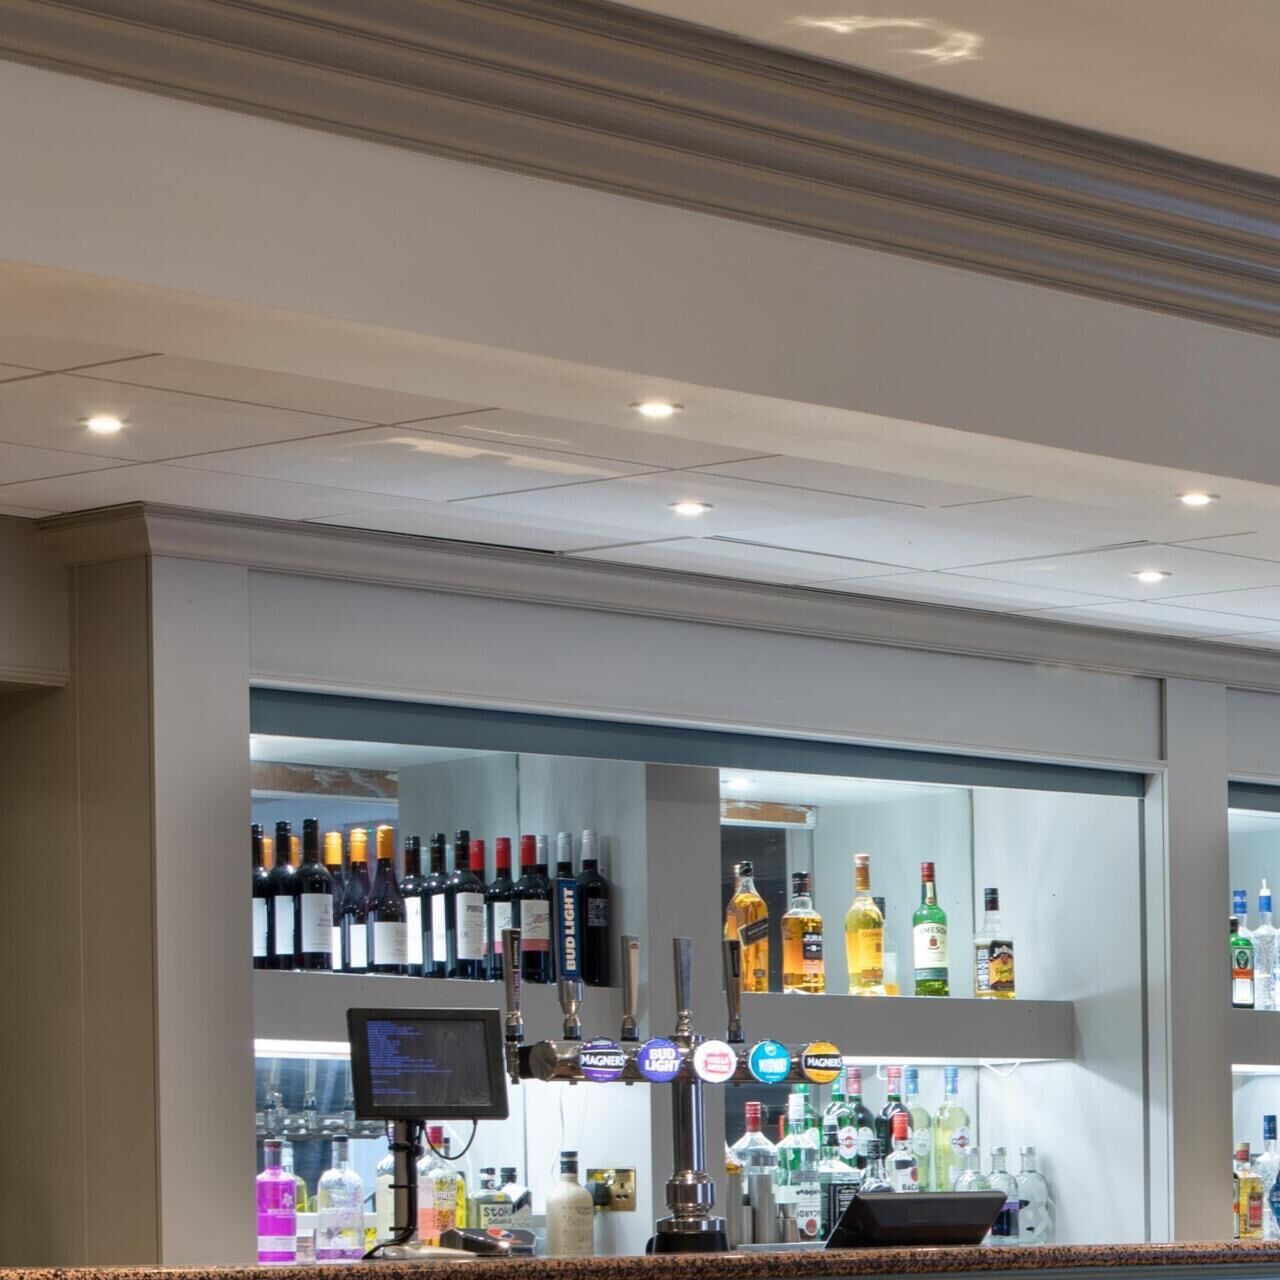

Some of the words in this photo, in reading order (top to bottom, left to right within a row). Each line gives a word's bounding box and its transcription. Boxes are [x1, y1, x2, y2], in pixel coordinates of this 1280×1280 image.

[563, 887, 576, 936] LIGHT
[802, 934, 824, 943] JURA
[564, 937, 577, 971] BUD
[580, 1053, 625, 1067] MAGNERS
[649, 1047, 676, 1060] BUD
[645, 1059, 679, 1073] LIGHT
[807, 1056, 842, 1068] MAGNERS
